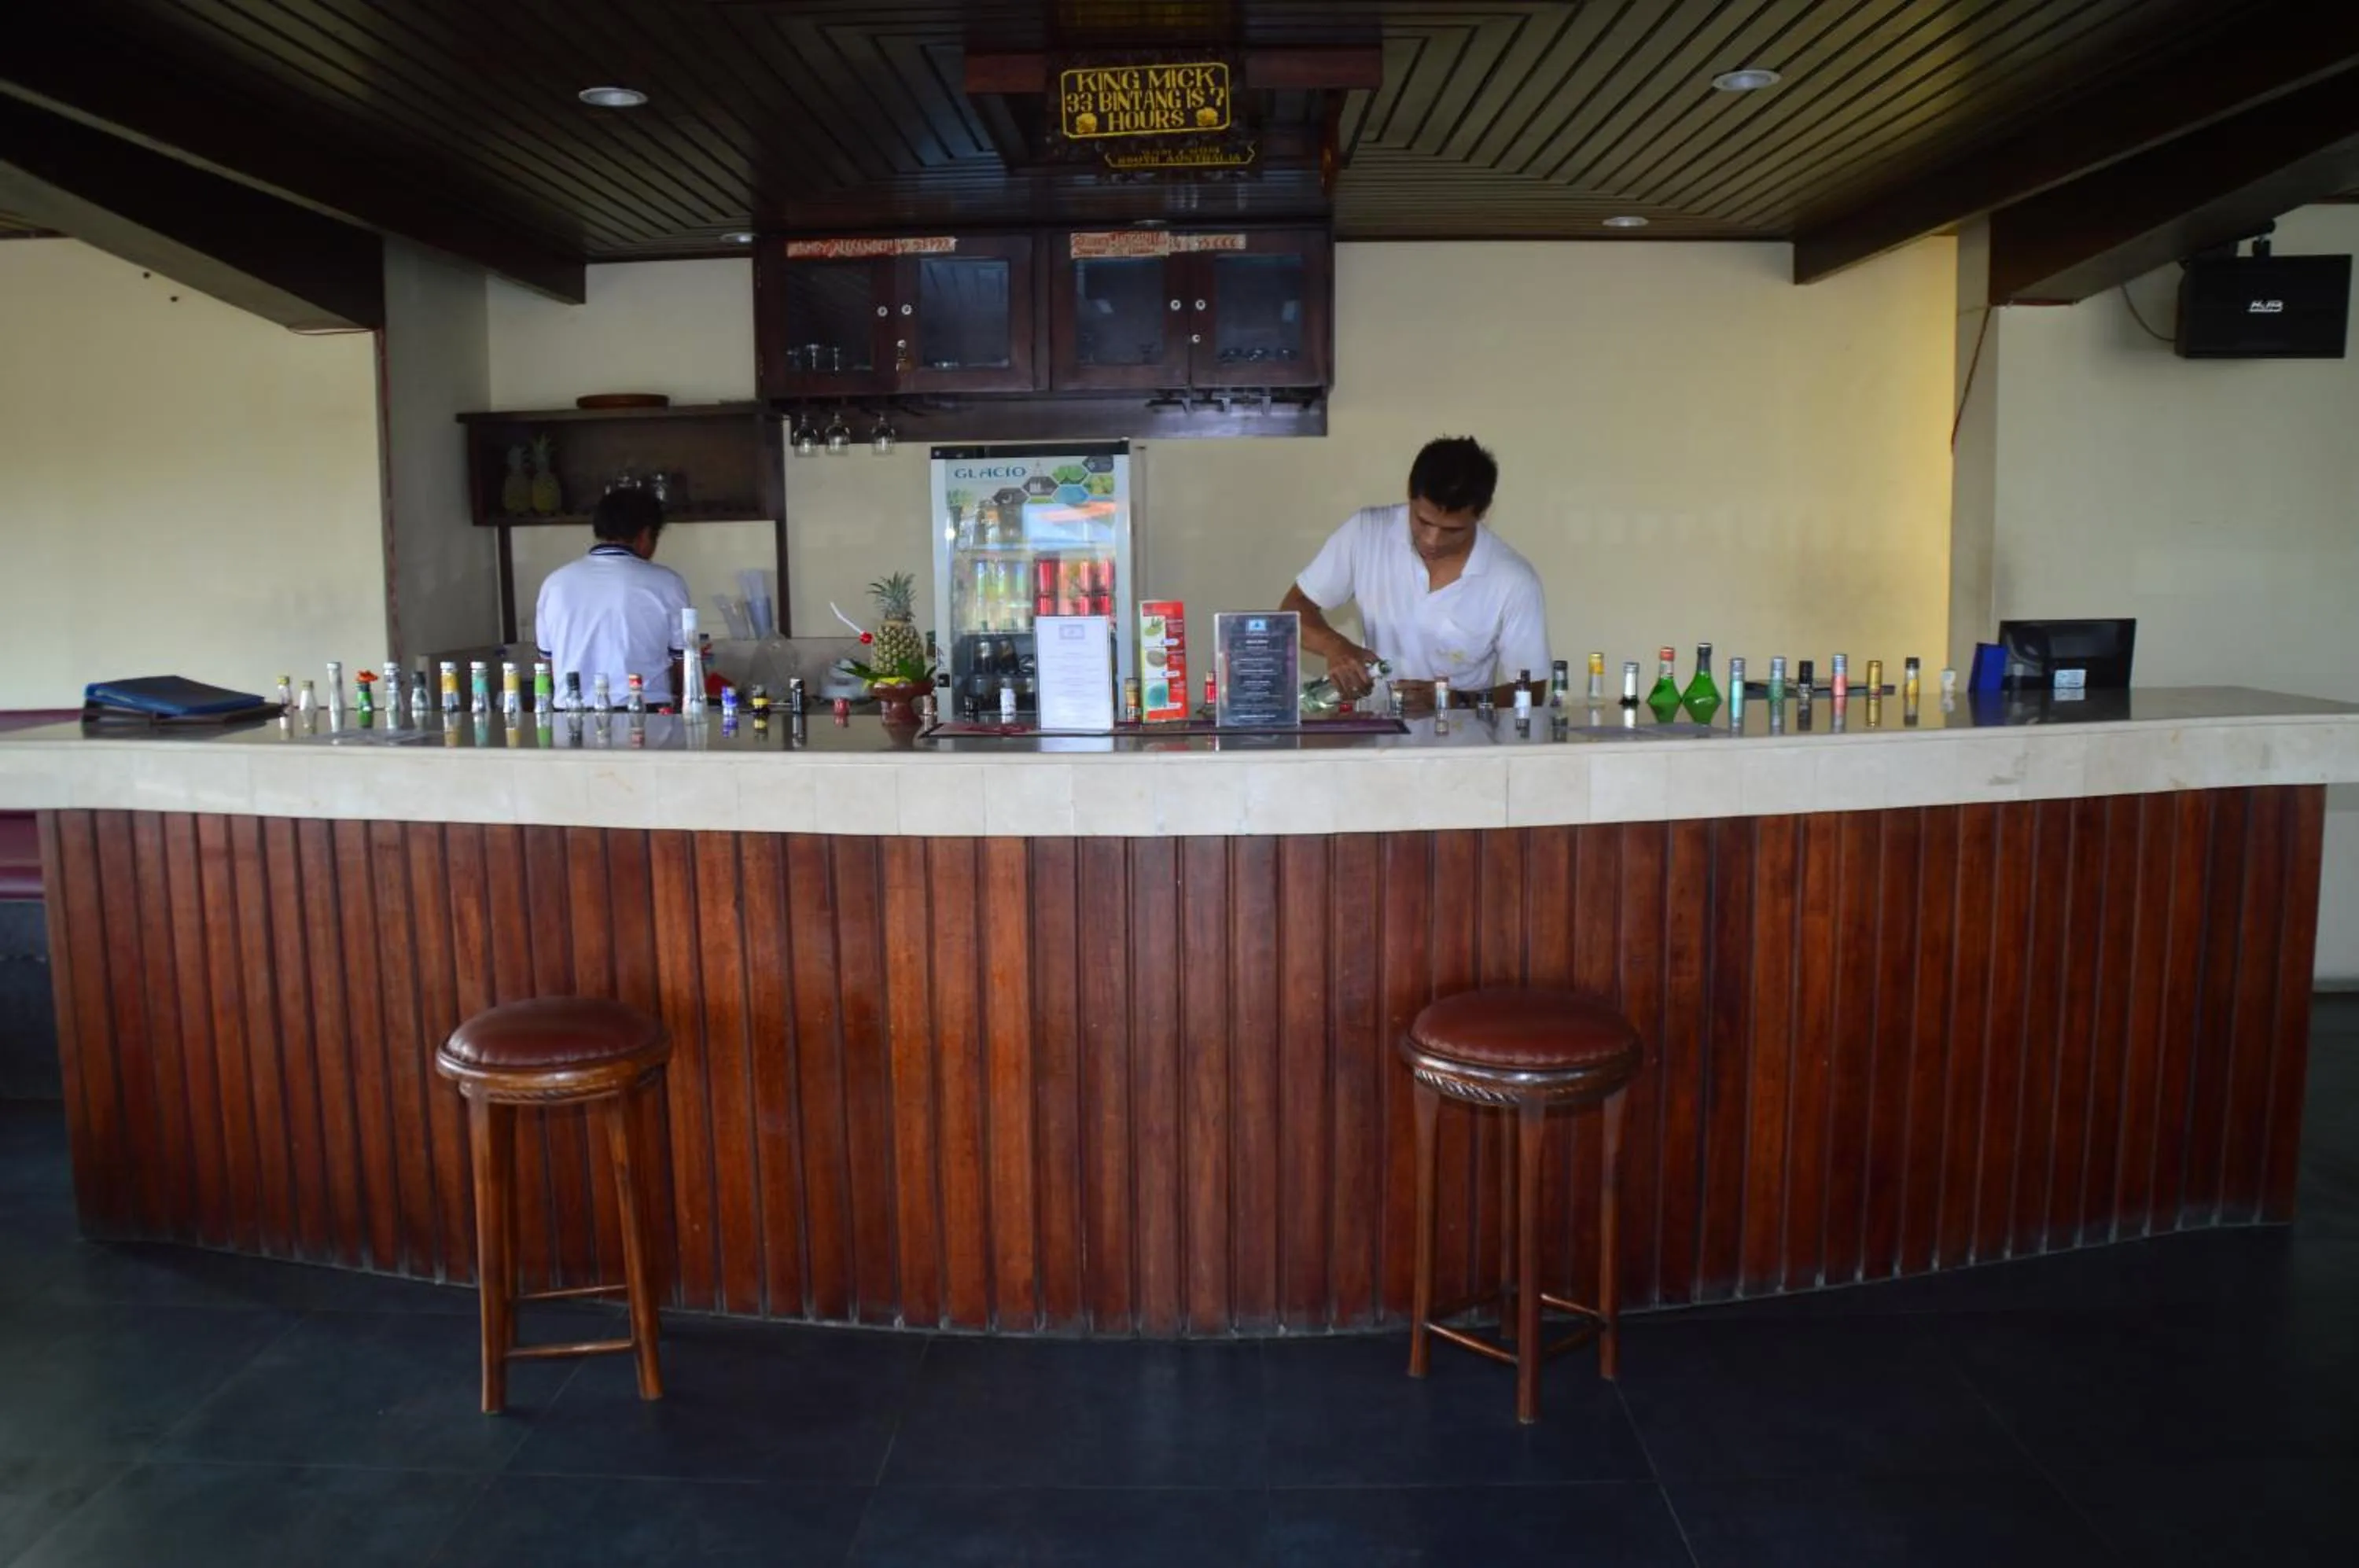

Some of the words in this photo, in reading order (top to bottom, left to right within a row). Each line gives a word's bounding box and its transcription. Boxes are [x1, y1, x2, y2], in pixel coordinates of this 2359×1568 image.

[1076, 69, 1140, 93] KING
[1147, 66, 1216, 90] MICK
[1065, 91, 1093, 113] 33
[1099, 89, 1182, 113] BINTANG
[1107, 109, 1186, 132] HOURS
[954, 466, 1027, 479] GLACIO
